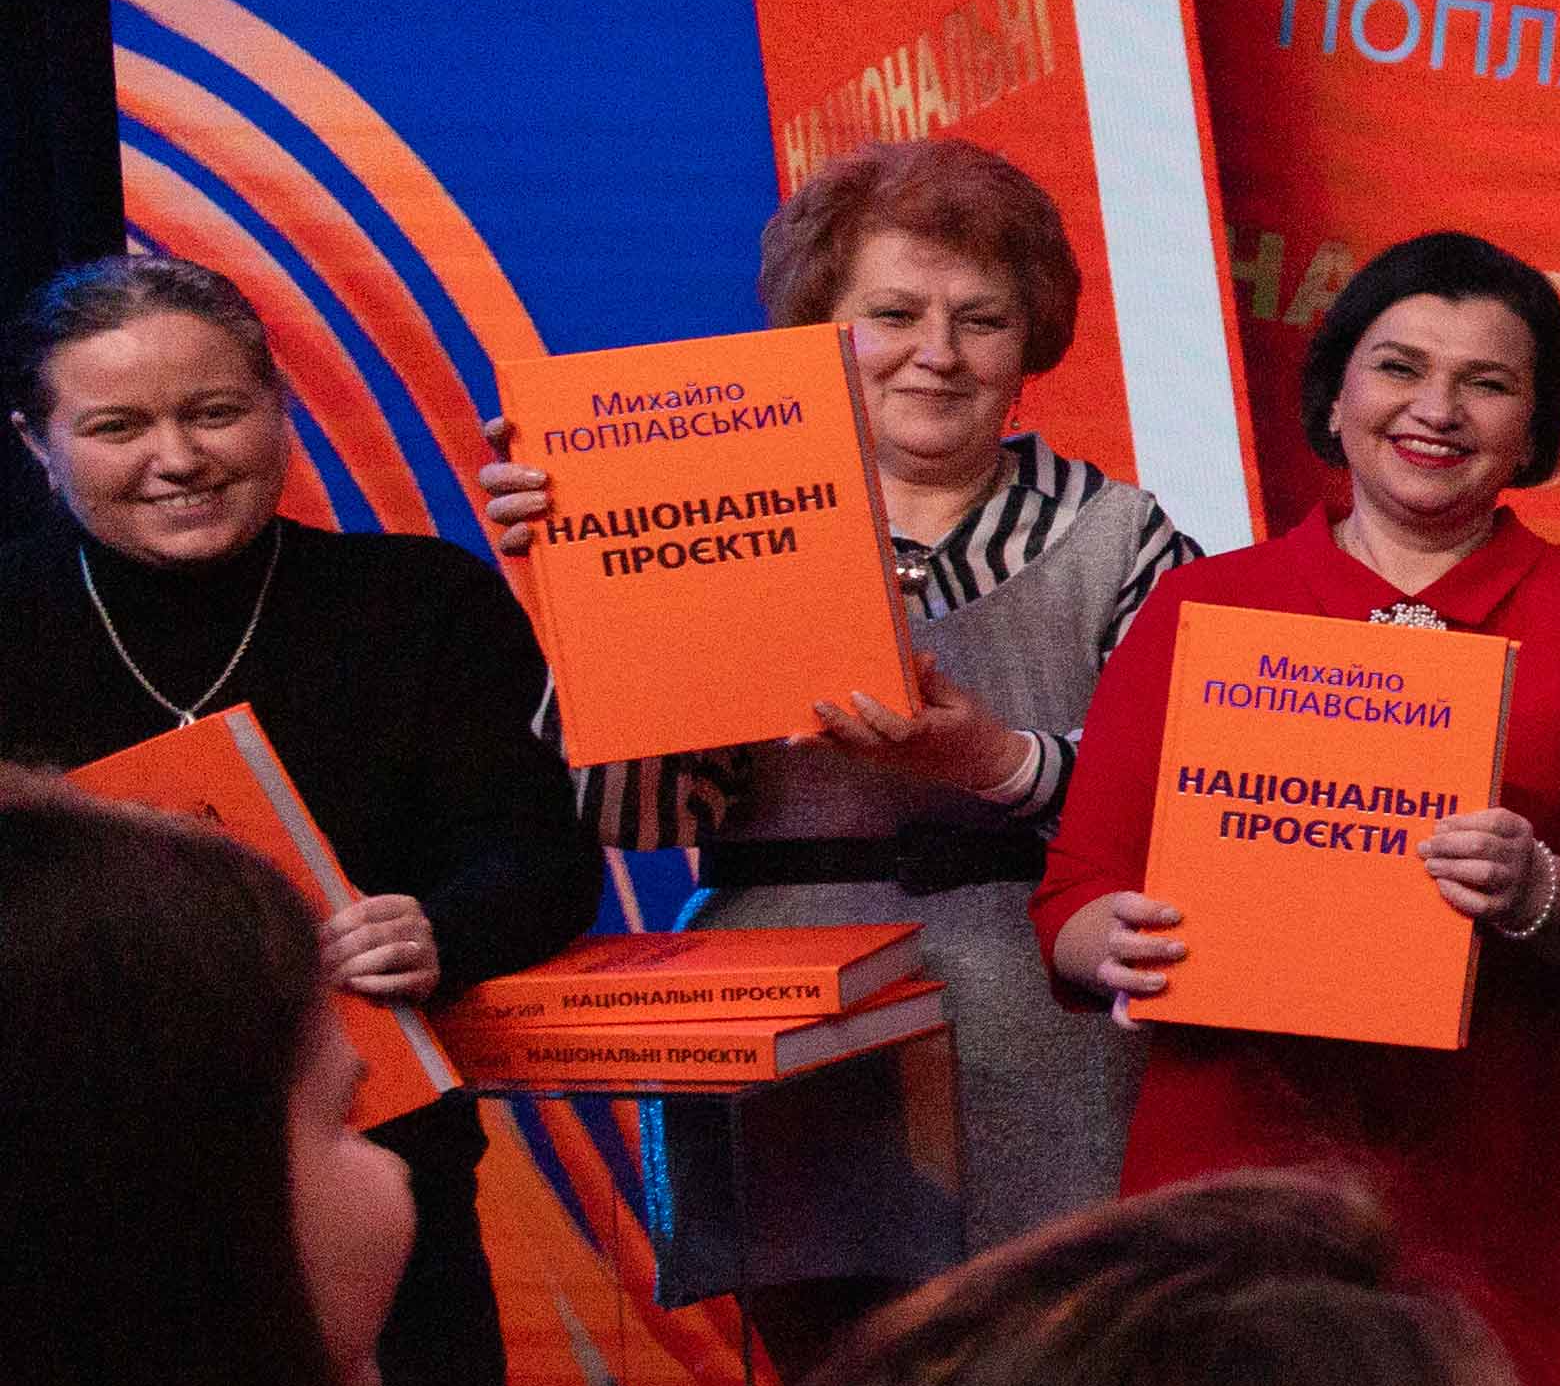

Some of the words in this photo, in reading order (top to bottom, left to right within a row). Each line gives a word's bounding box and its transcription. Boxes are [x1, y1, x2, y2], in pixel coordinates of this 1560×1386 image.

[592, 382, 745, 417] Михайло
[544, 397, 803, 455] ПОПЛАВСЬКИЙ
[546, 483, 837, 544] НАЦІОНАЛЬНІ
[602, 527, 797, 576] ПРОЄКТИ
[1258, 654, 1405, 693] Михайло
[1203, 679, 1452, 729] ПОПЛАВСЬКИЙ
[1177, 766, 1459, 819] НАЦІОНАЛЬНІ
[1219, 811, 1409, 856] ПРОЄКТИ
[561, 988, 713, 1010] НАЦІОНАЛЬНІ
[720, 984, 821, 1003] ПРОЄКТИ
[666, 1048, 758, 1064] ПРОЄКТИ
